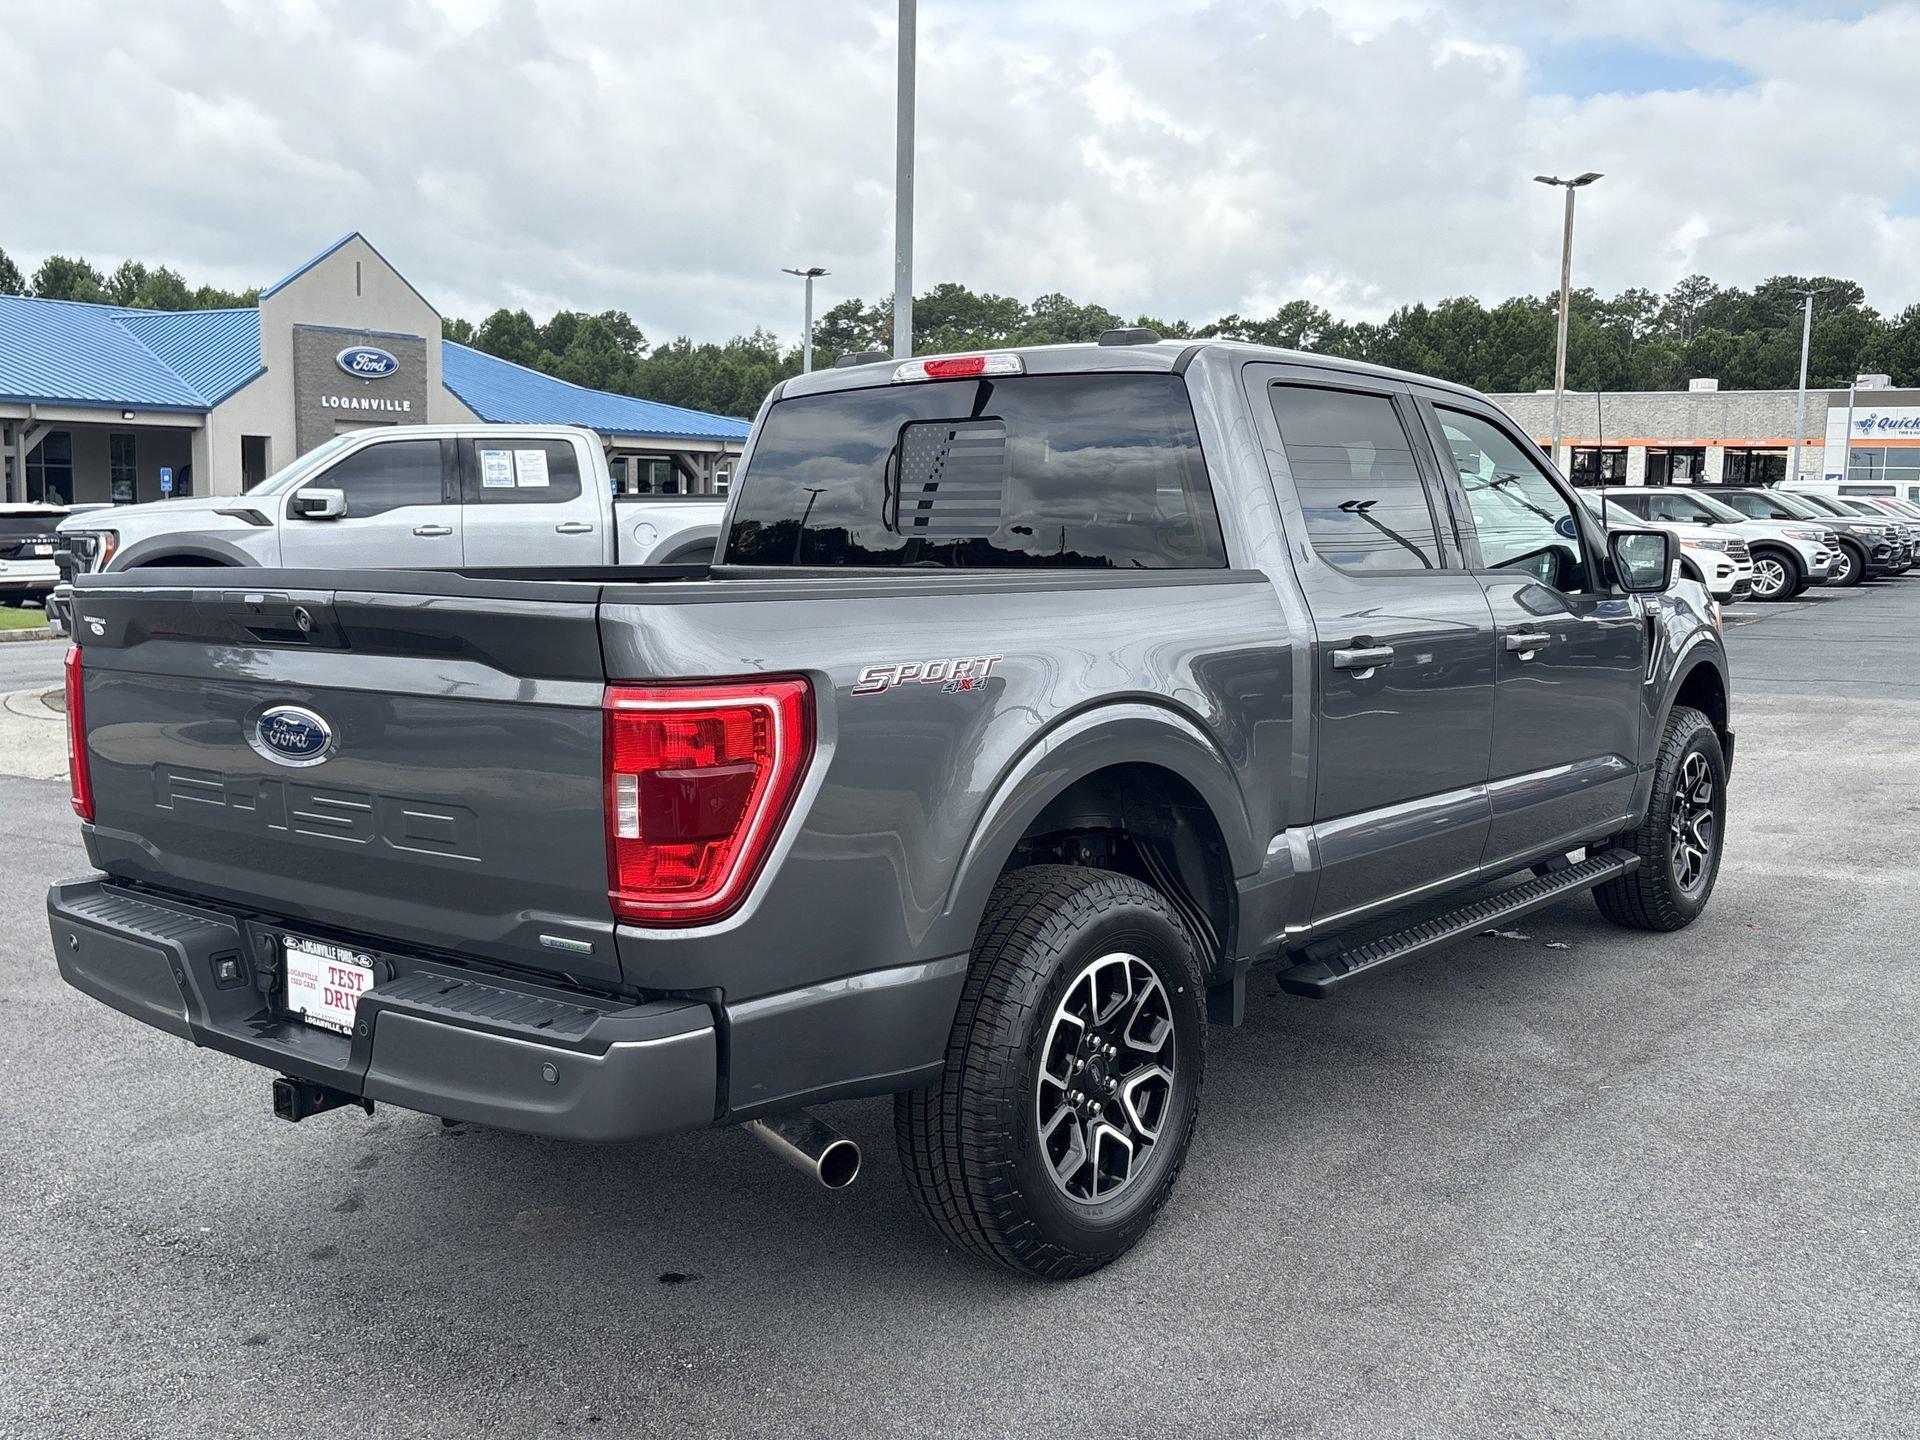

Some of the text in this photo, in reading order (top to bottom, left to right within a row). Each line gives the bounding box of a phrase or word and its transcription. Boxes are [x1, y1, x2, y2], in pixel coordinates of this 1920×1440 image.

[353, 352, 387, 373] Ford
[321, 396, 412, 412] LOGANVILLE
[1877, 416, 1920, 430] Quick
[851, 654, 1004, 696] SPORT
[269, 716, 311, 749] Ford
[301, 940, 337, 960] LOGANVILLE
[336, 948, 355, 964] FORD
[328, 966, 364, 992] TEST
[323, 986, 361, 1012] DRIV
